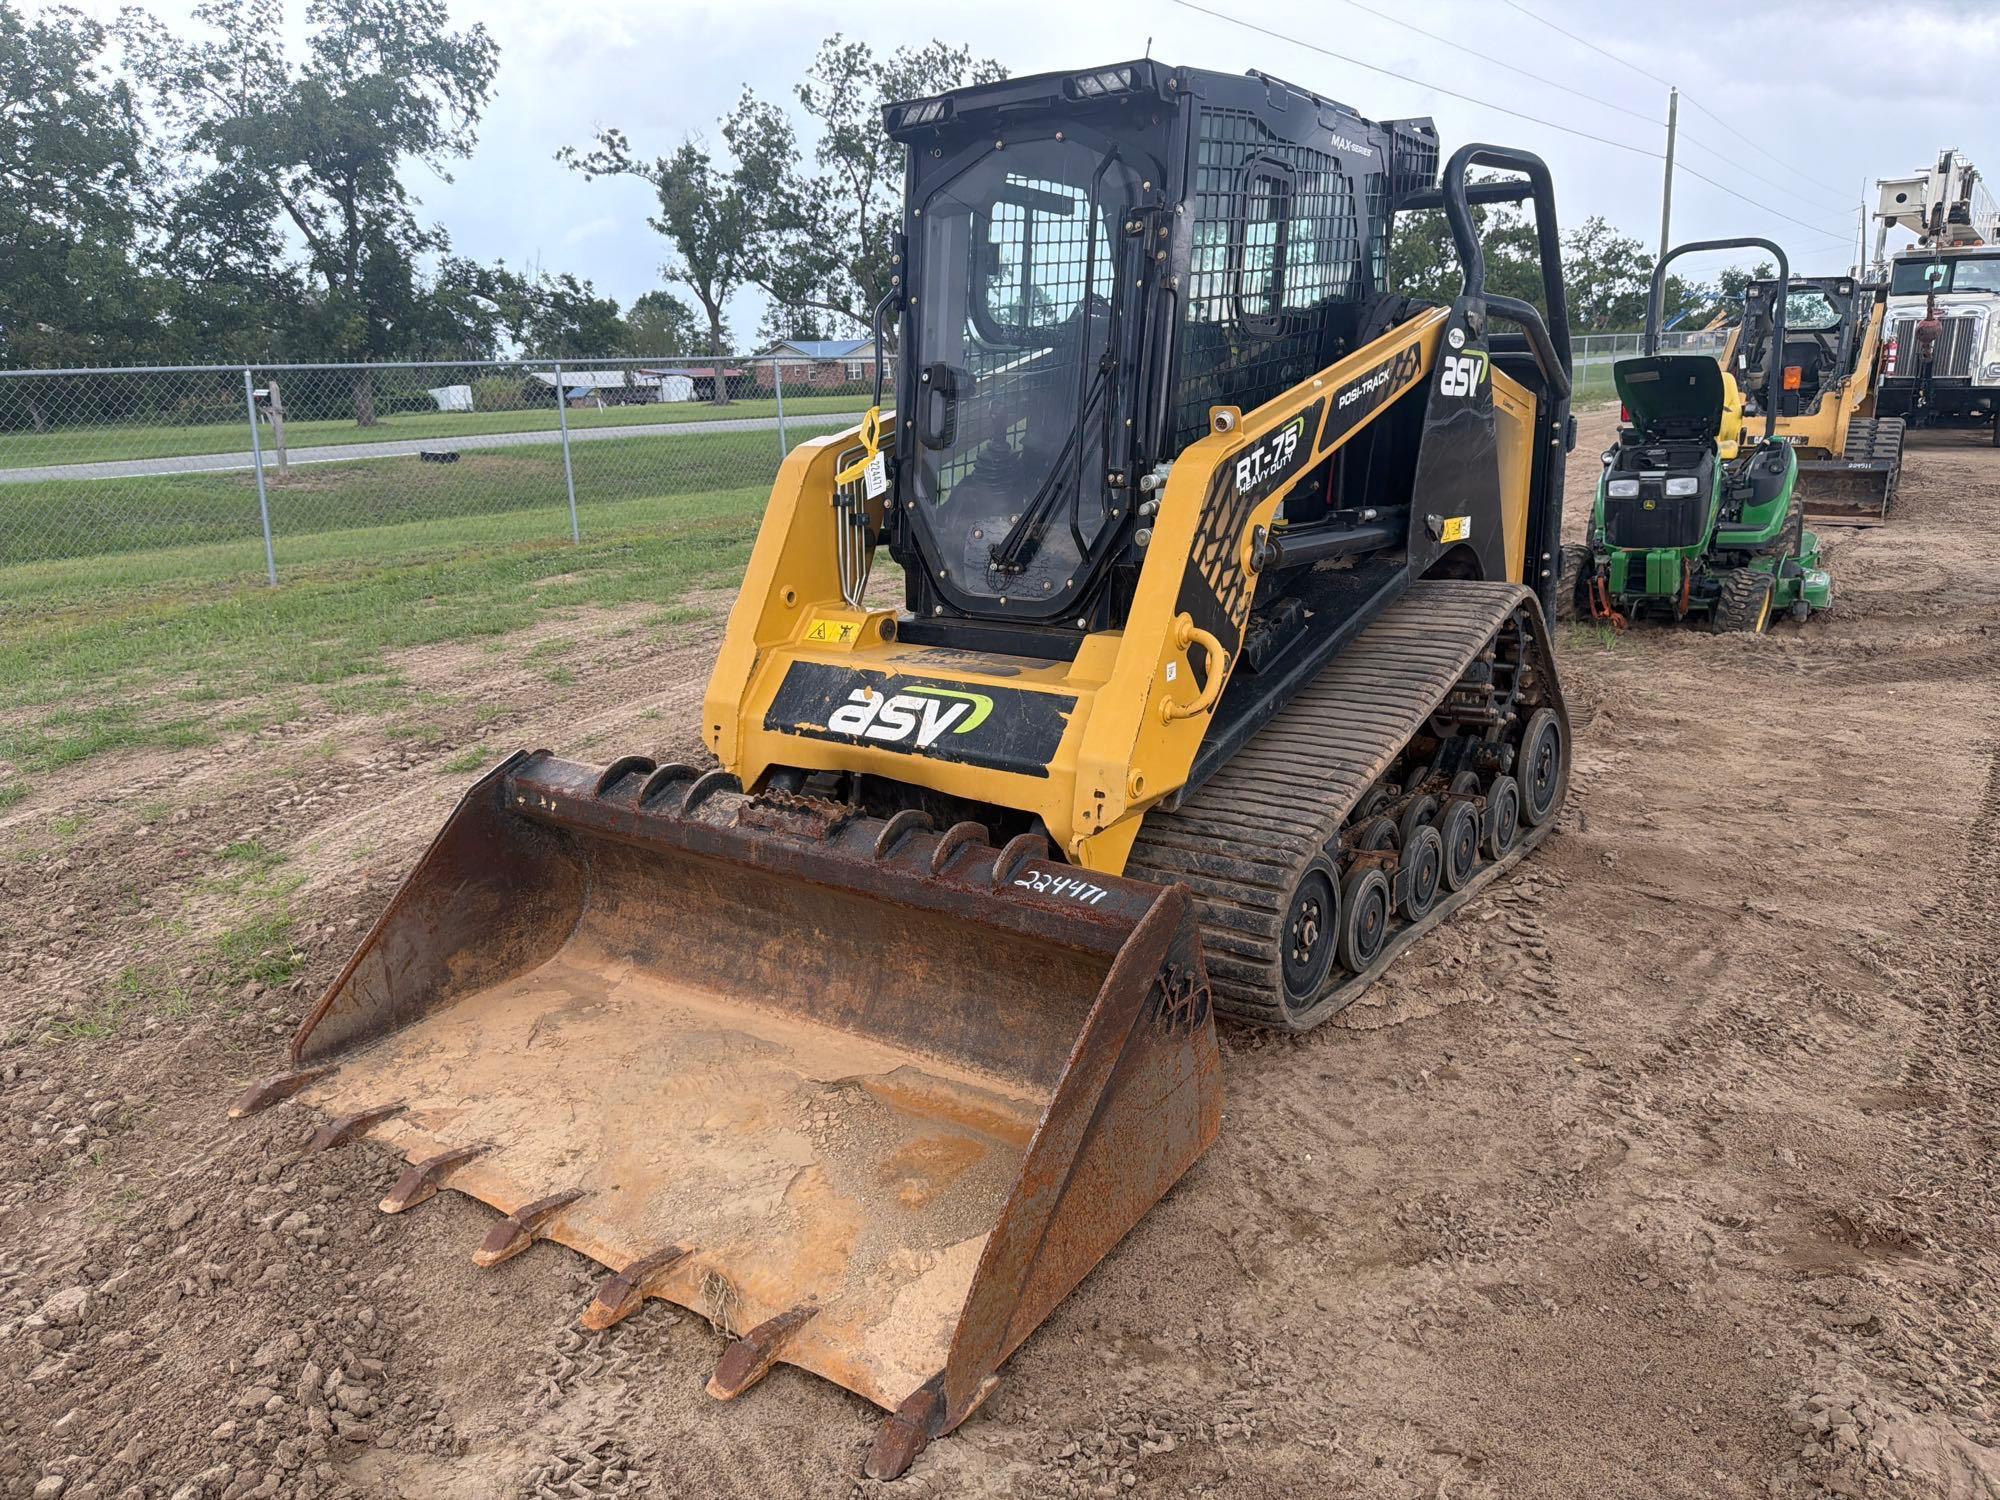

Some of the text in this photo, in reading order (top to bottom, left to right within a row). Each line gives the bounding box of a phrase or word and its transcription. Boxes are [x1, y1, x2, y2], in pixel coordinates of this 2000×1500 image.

[1338, 368, 1390, 410] POSI-TRACK
[870, 460, 883, 491] 224471
[1236, 425, 1298, 489] RT-75
[1239, 451, 1294, 496] HEAVY DUTY
[1013, 870, 1108, 905] 224471
